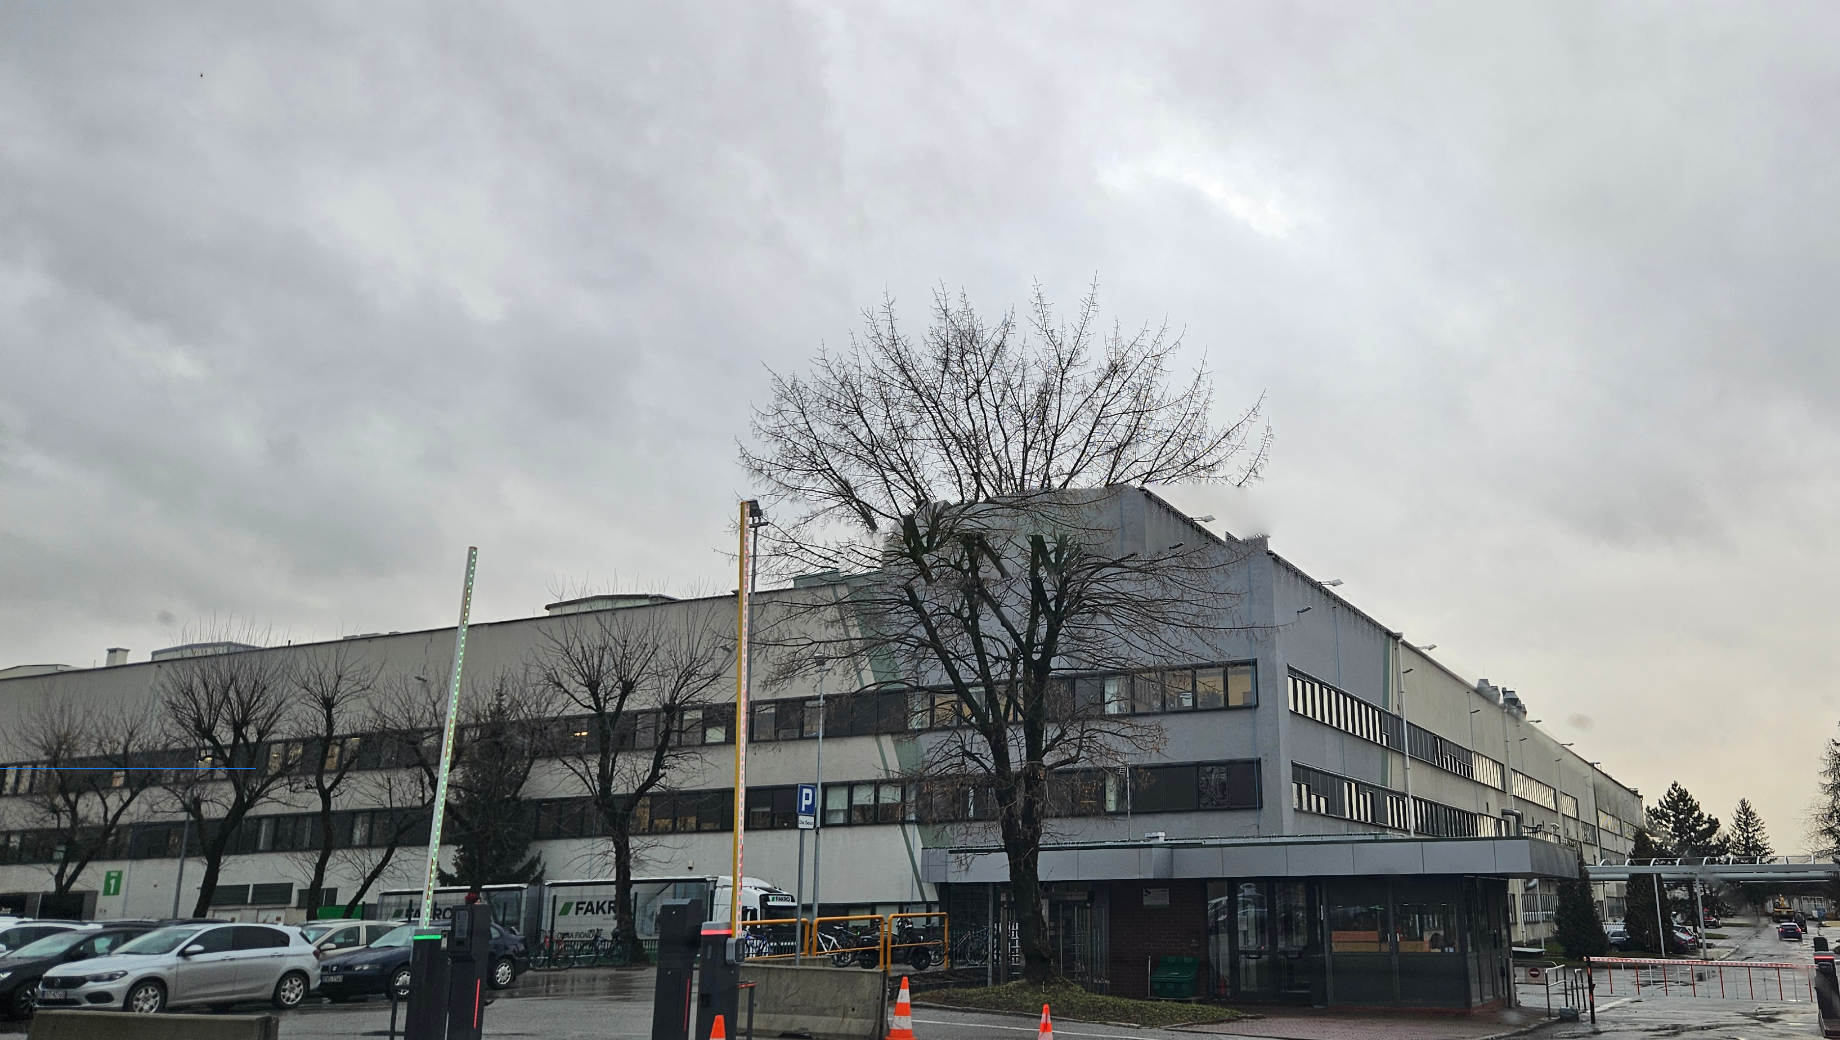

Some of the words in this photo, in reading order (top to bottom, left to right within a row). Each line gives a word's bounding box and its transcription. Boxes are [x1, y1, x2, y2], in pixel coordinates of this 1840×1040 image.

[802, 788, 812, 811] P
[405, 906, 453, 920] FARO
[575, 900, 617, 916] FAKR
